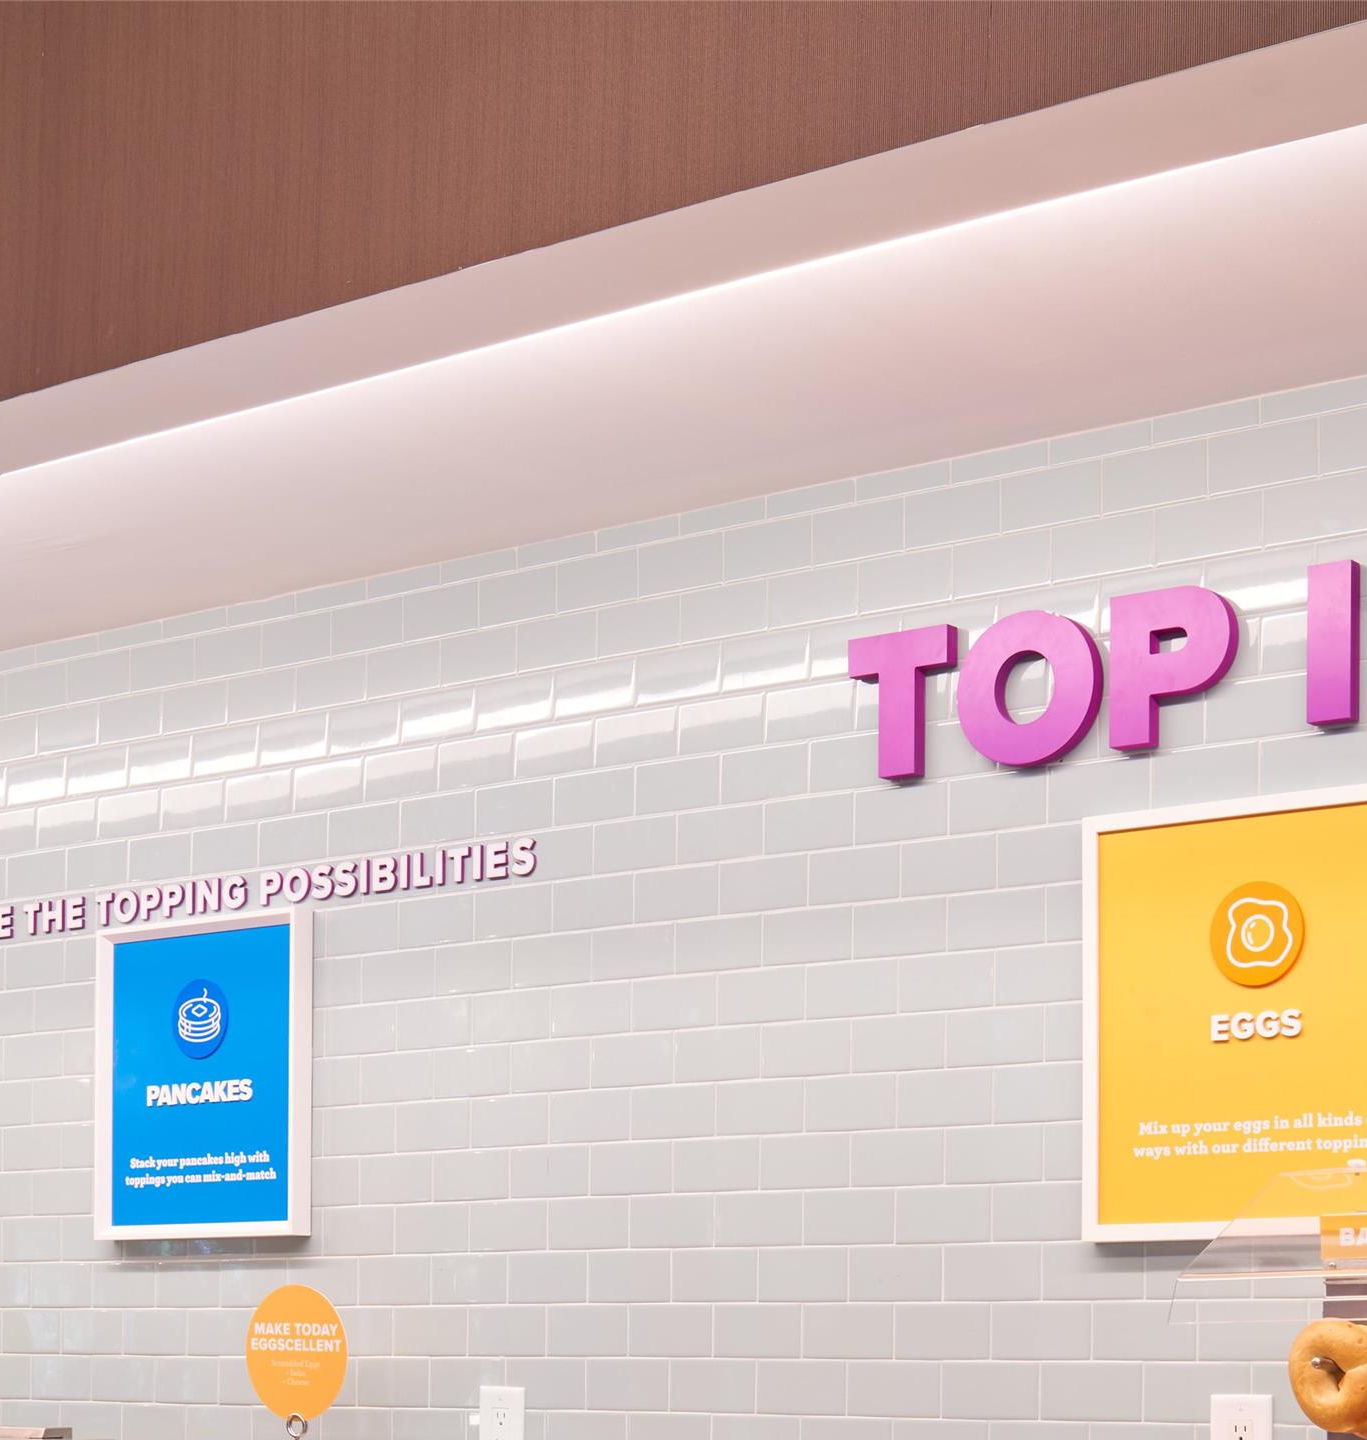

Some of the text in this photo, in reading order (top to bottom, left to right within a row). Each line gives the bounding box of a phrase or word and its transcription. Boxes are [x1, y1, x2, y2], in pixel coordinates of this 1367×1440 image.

[848, 584, 1239, 783] TOP
[23, 896, 86, 935] THE
[96, 874, 248, 927] TOPPING
[259, 837, 537, 906] POSSIBILITIES
[1210, 1008, 1303, 1043] EGGS
[146, 1078, 253, 1107] PANCAKES
[1139, 1121, 1169, 1136] Mix
[1171, 1122, 1190, 1137] up
[1193, 1120, 1229, 1137] your
[1233, 1118, 1270, 1134] eggs
[1273, 1115, 1290, 1130] in
[1293, 1113, 1314, 1128] all
[1317, 1111, 1363, 1129] kinds
[130, 1150, 270, 1170] Stack your pancakes high with
[1133, 1143, 1170, 1160] ways
[1174, 1140, 1209, 1156] with
[1212, 1142, 1239, 1154] our
[1242, 1136, 1313, 1152] different
[125, 1167, 277, 1188] toppings you can mix-and-match
[254, 1321, 338, 1337] MAKE TODAY
[251, 1336, 342, 1353] EGGSCELLENT
